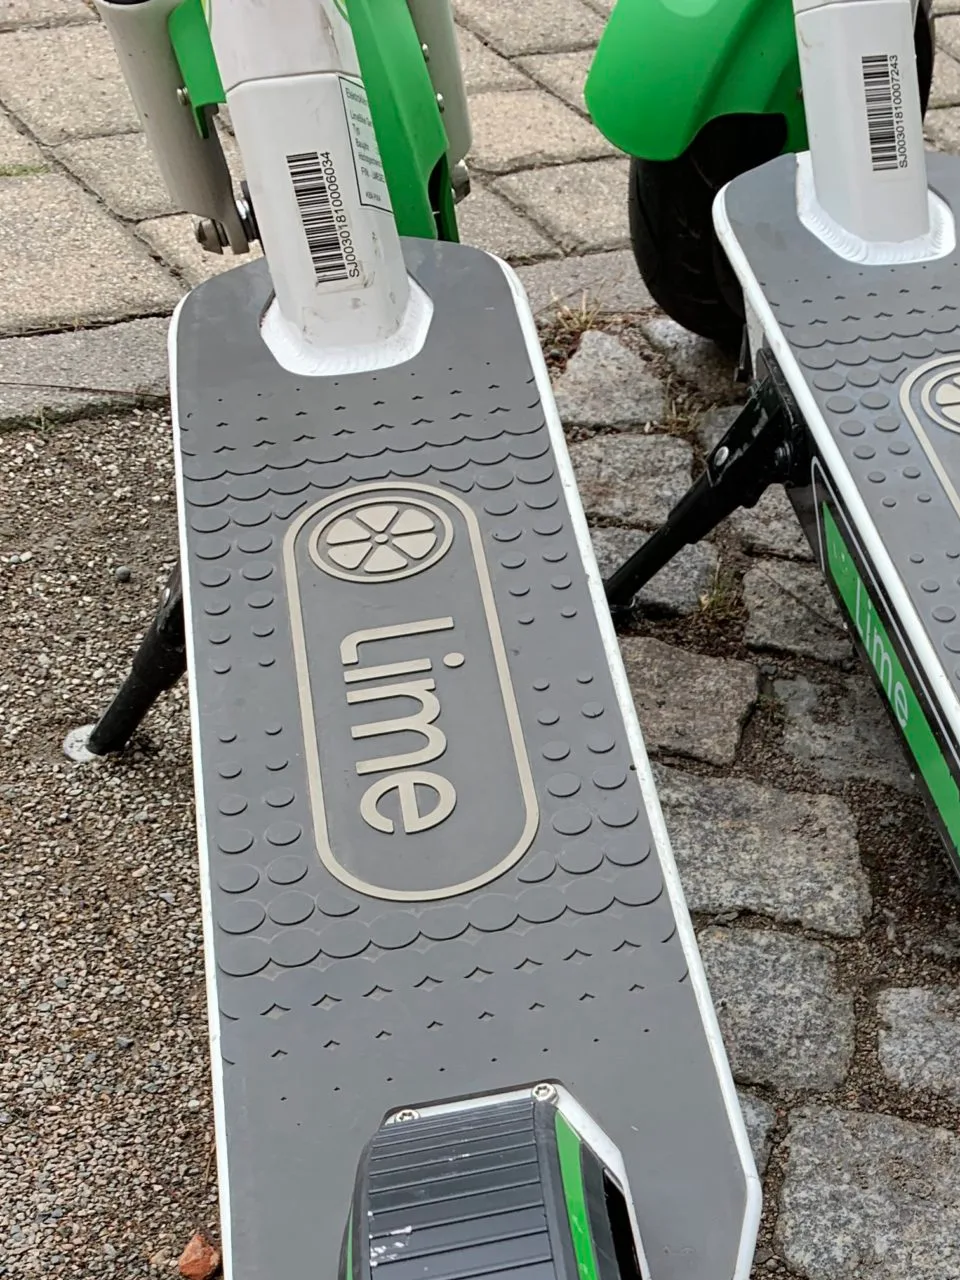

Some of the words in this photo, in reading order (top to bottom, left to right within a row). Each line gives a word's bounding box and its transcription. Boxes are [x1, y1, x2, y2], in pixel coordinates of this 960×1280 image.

[889, 54, 908, 168] SJ00301810007243
[320, 151, 360, 278] SJ00301810006034
[856, 577, 908, 728] Lime
[340, 616, 465, 834] Lime
